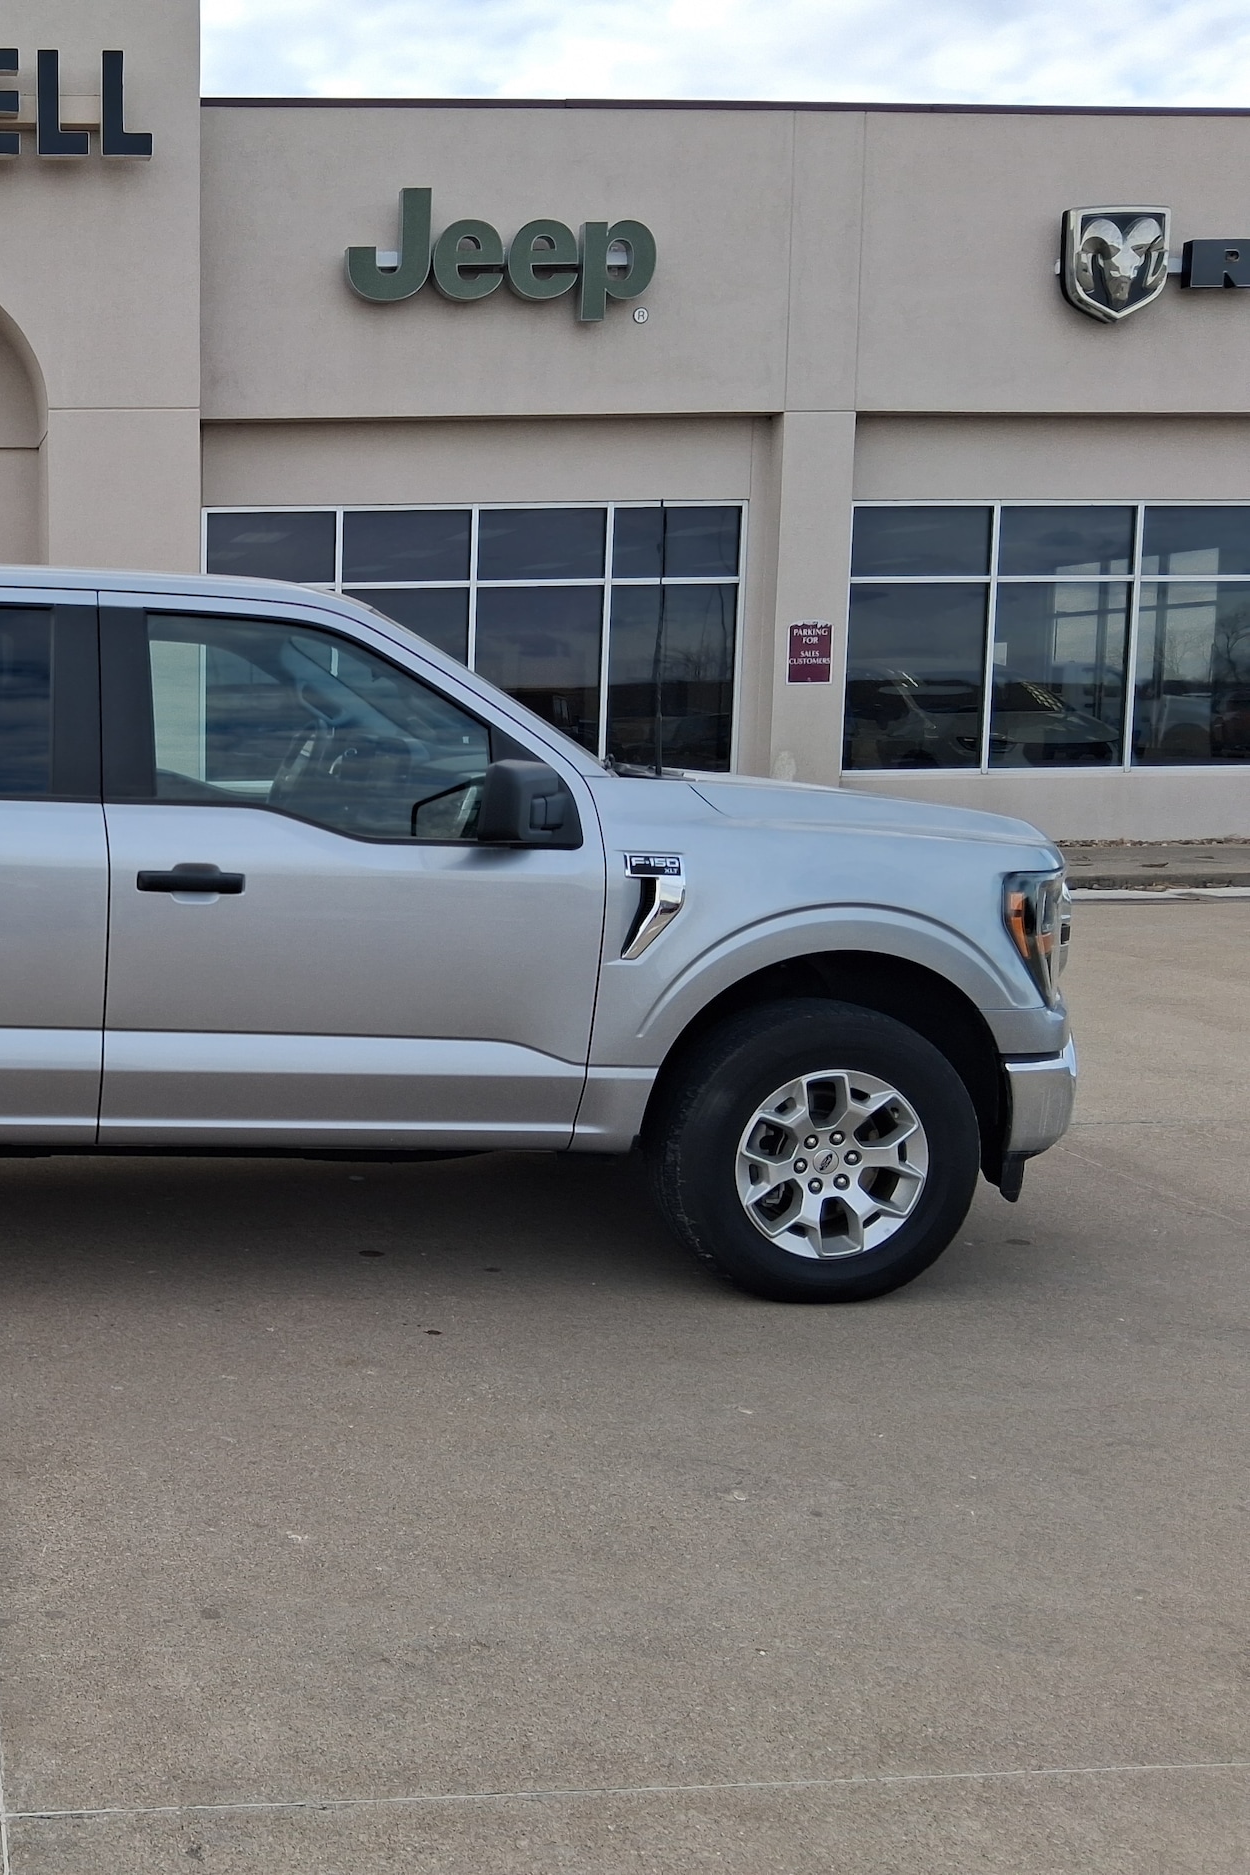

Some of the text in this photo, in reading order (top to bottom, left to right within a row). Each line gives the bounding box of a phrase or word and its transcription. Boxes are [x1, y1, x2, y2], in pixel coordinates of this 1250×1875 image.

[345, 187, 656, 322] Jeep
[793, 628, 828, 636] PARKING
[802, 636, 819, 644] FOR
[788, 657, 831, 665] CUSTOMERS
[630, 856, 680, 868] F-150
